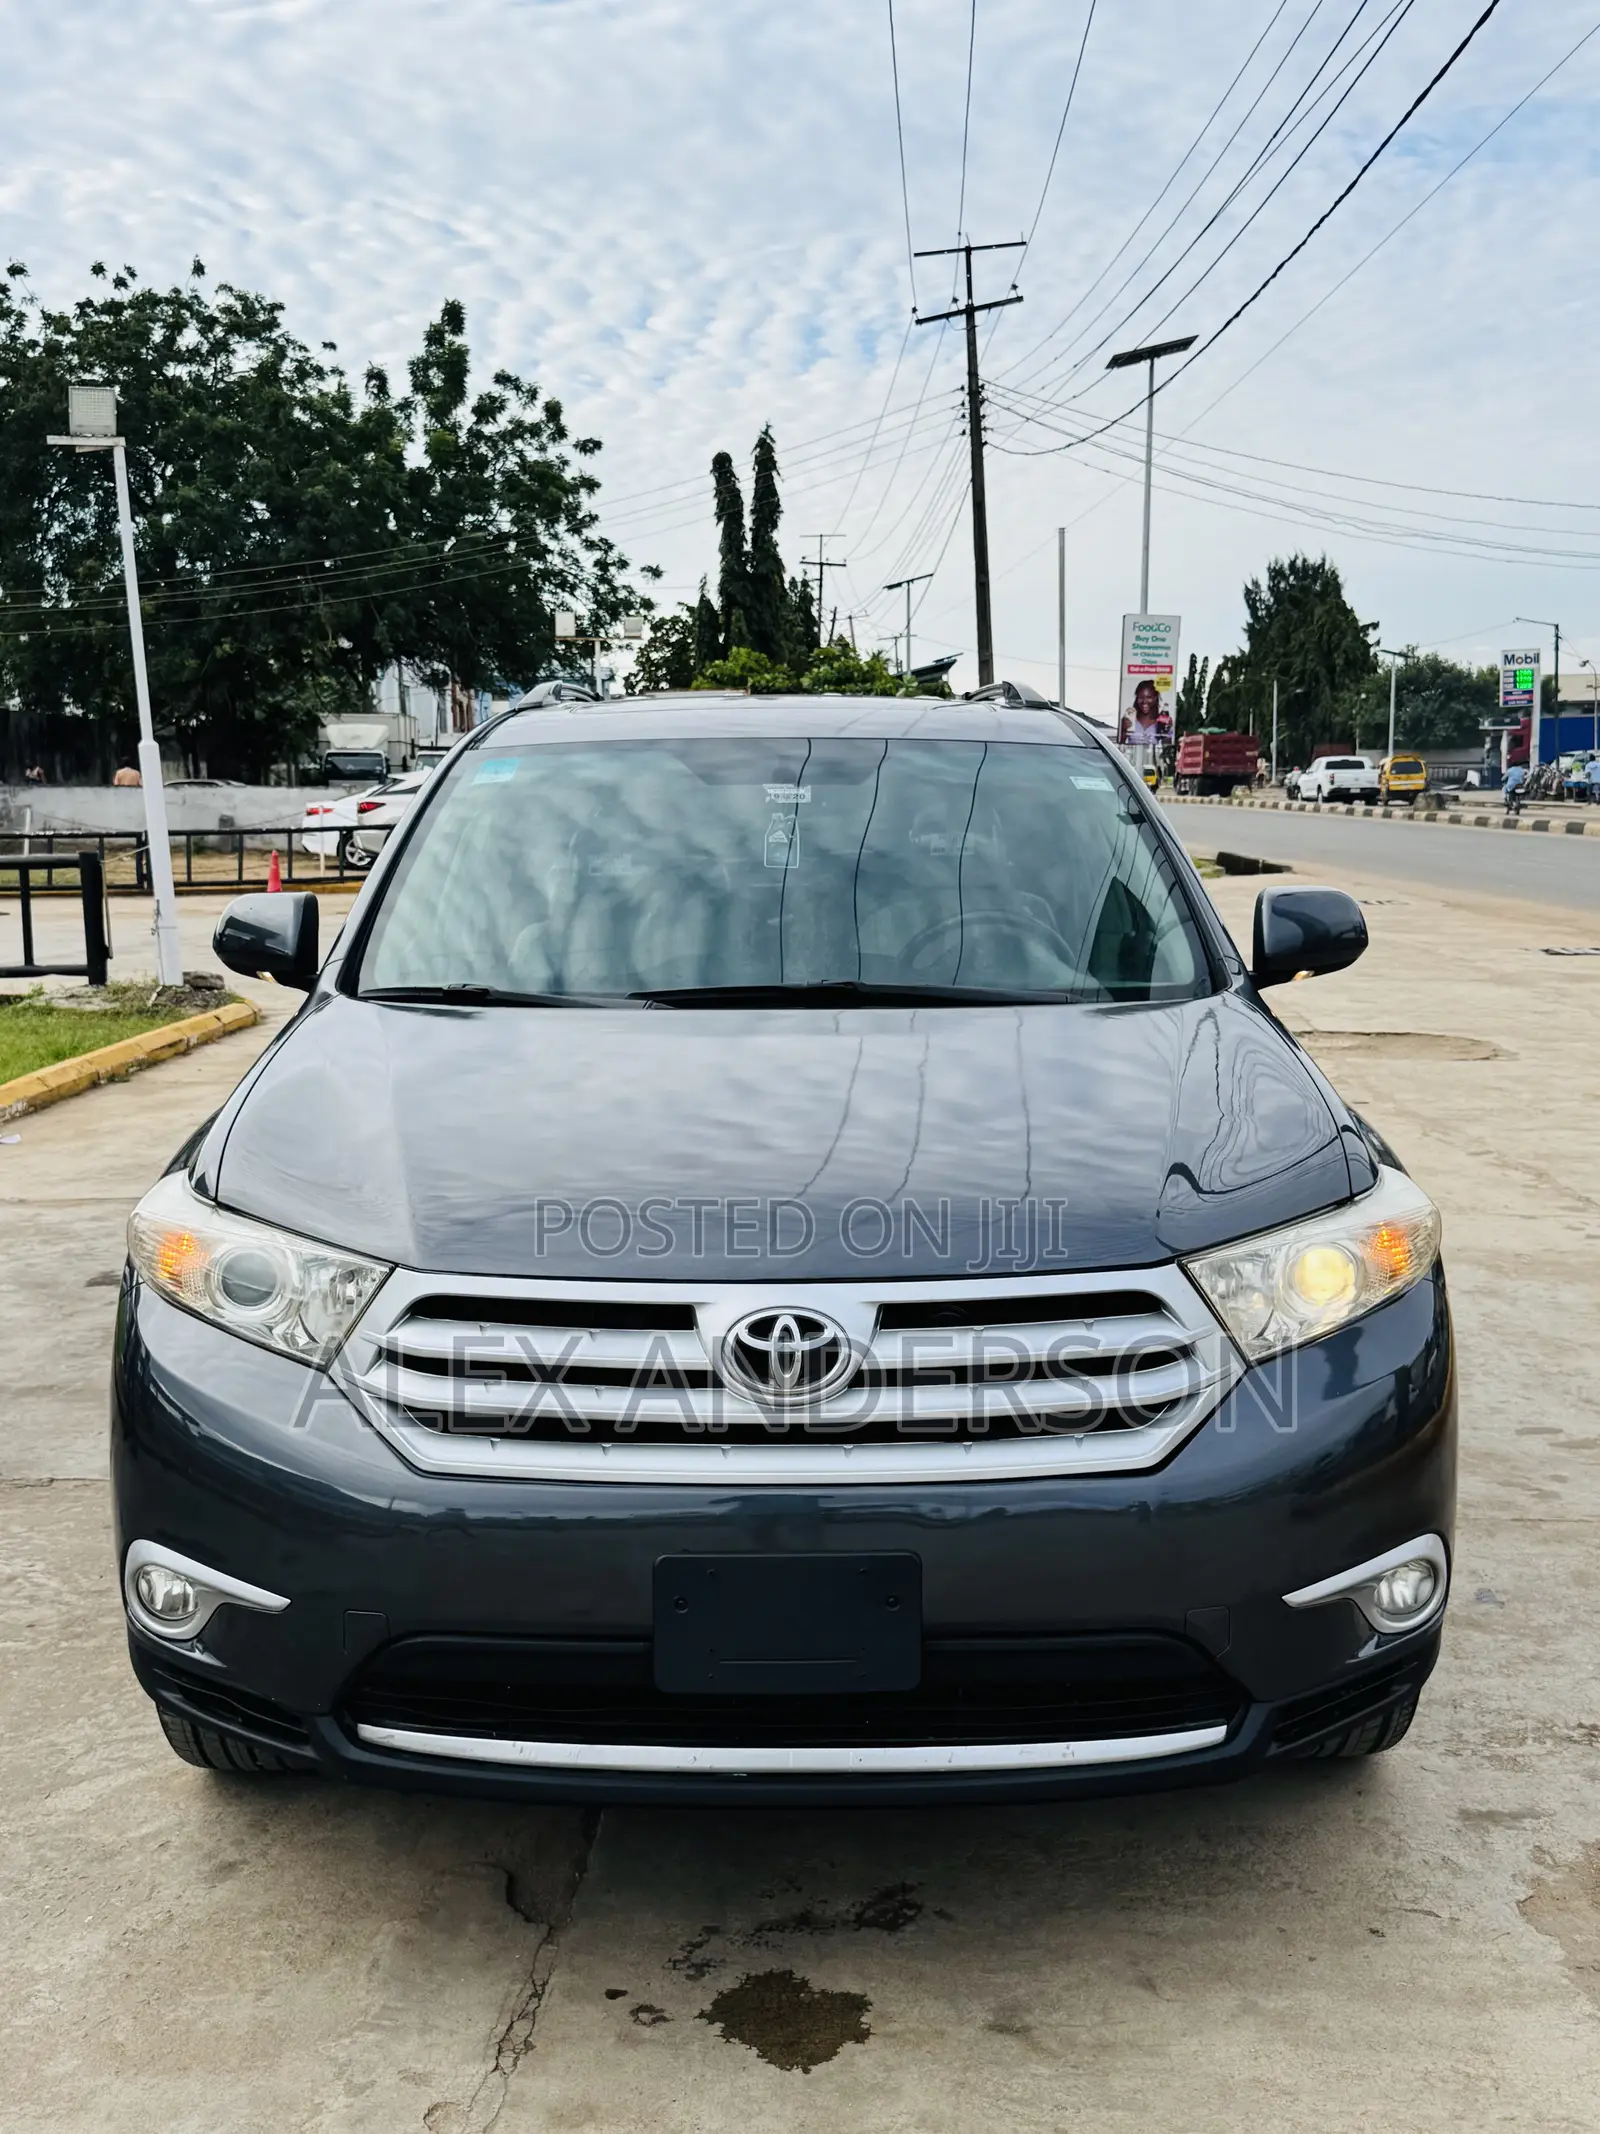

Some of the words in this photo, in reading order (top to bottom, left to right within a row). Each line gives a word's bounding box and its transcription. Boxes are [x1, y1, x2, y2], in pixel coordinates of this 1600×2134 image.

[1132, 622, 1171, 633] FoodCo
[1135, 635, 1149, 643] Buy
[1504, 652, 1540, 666] Mobil
